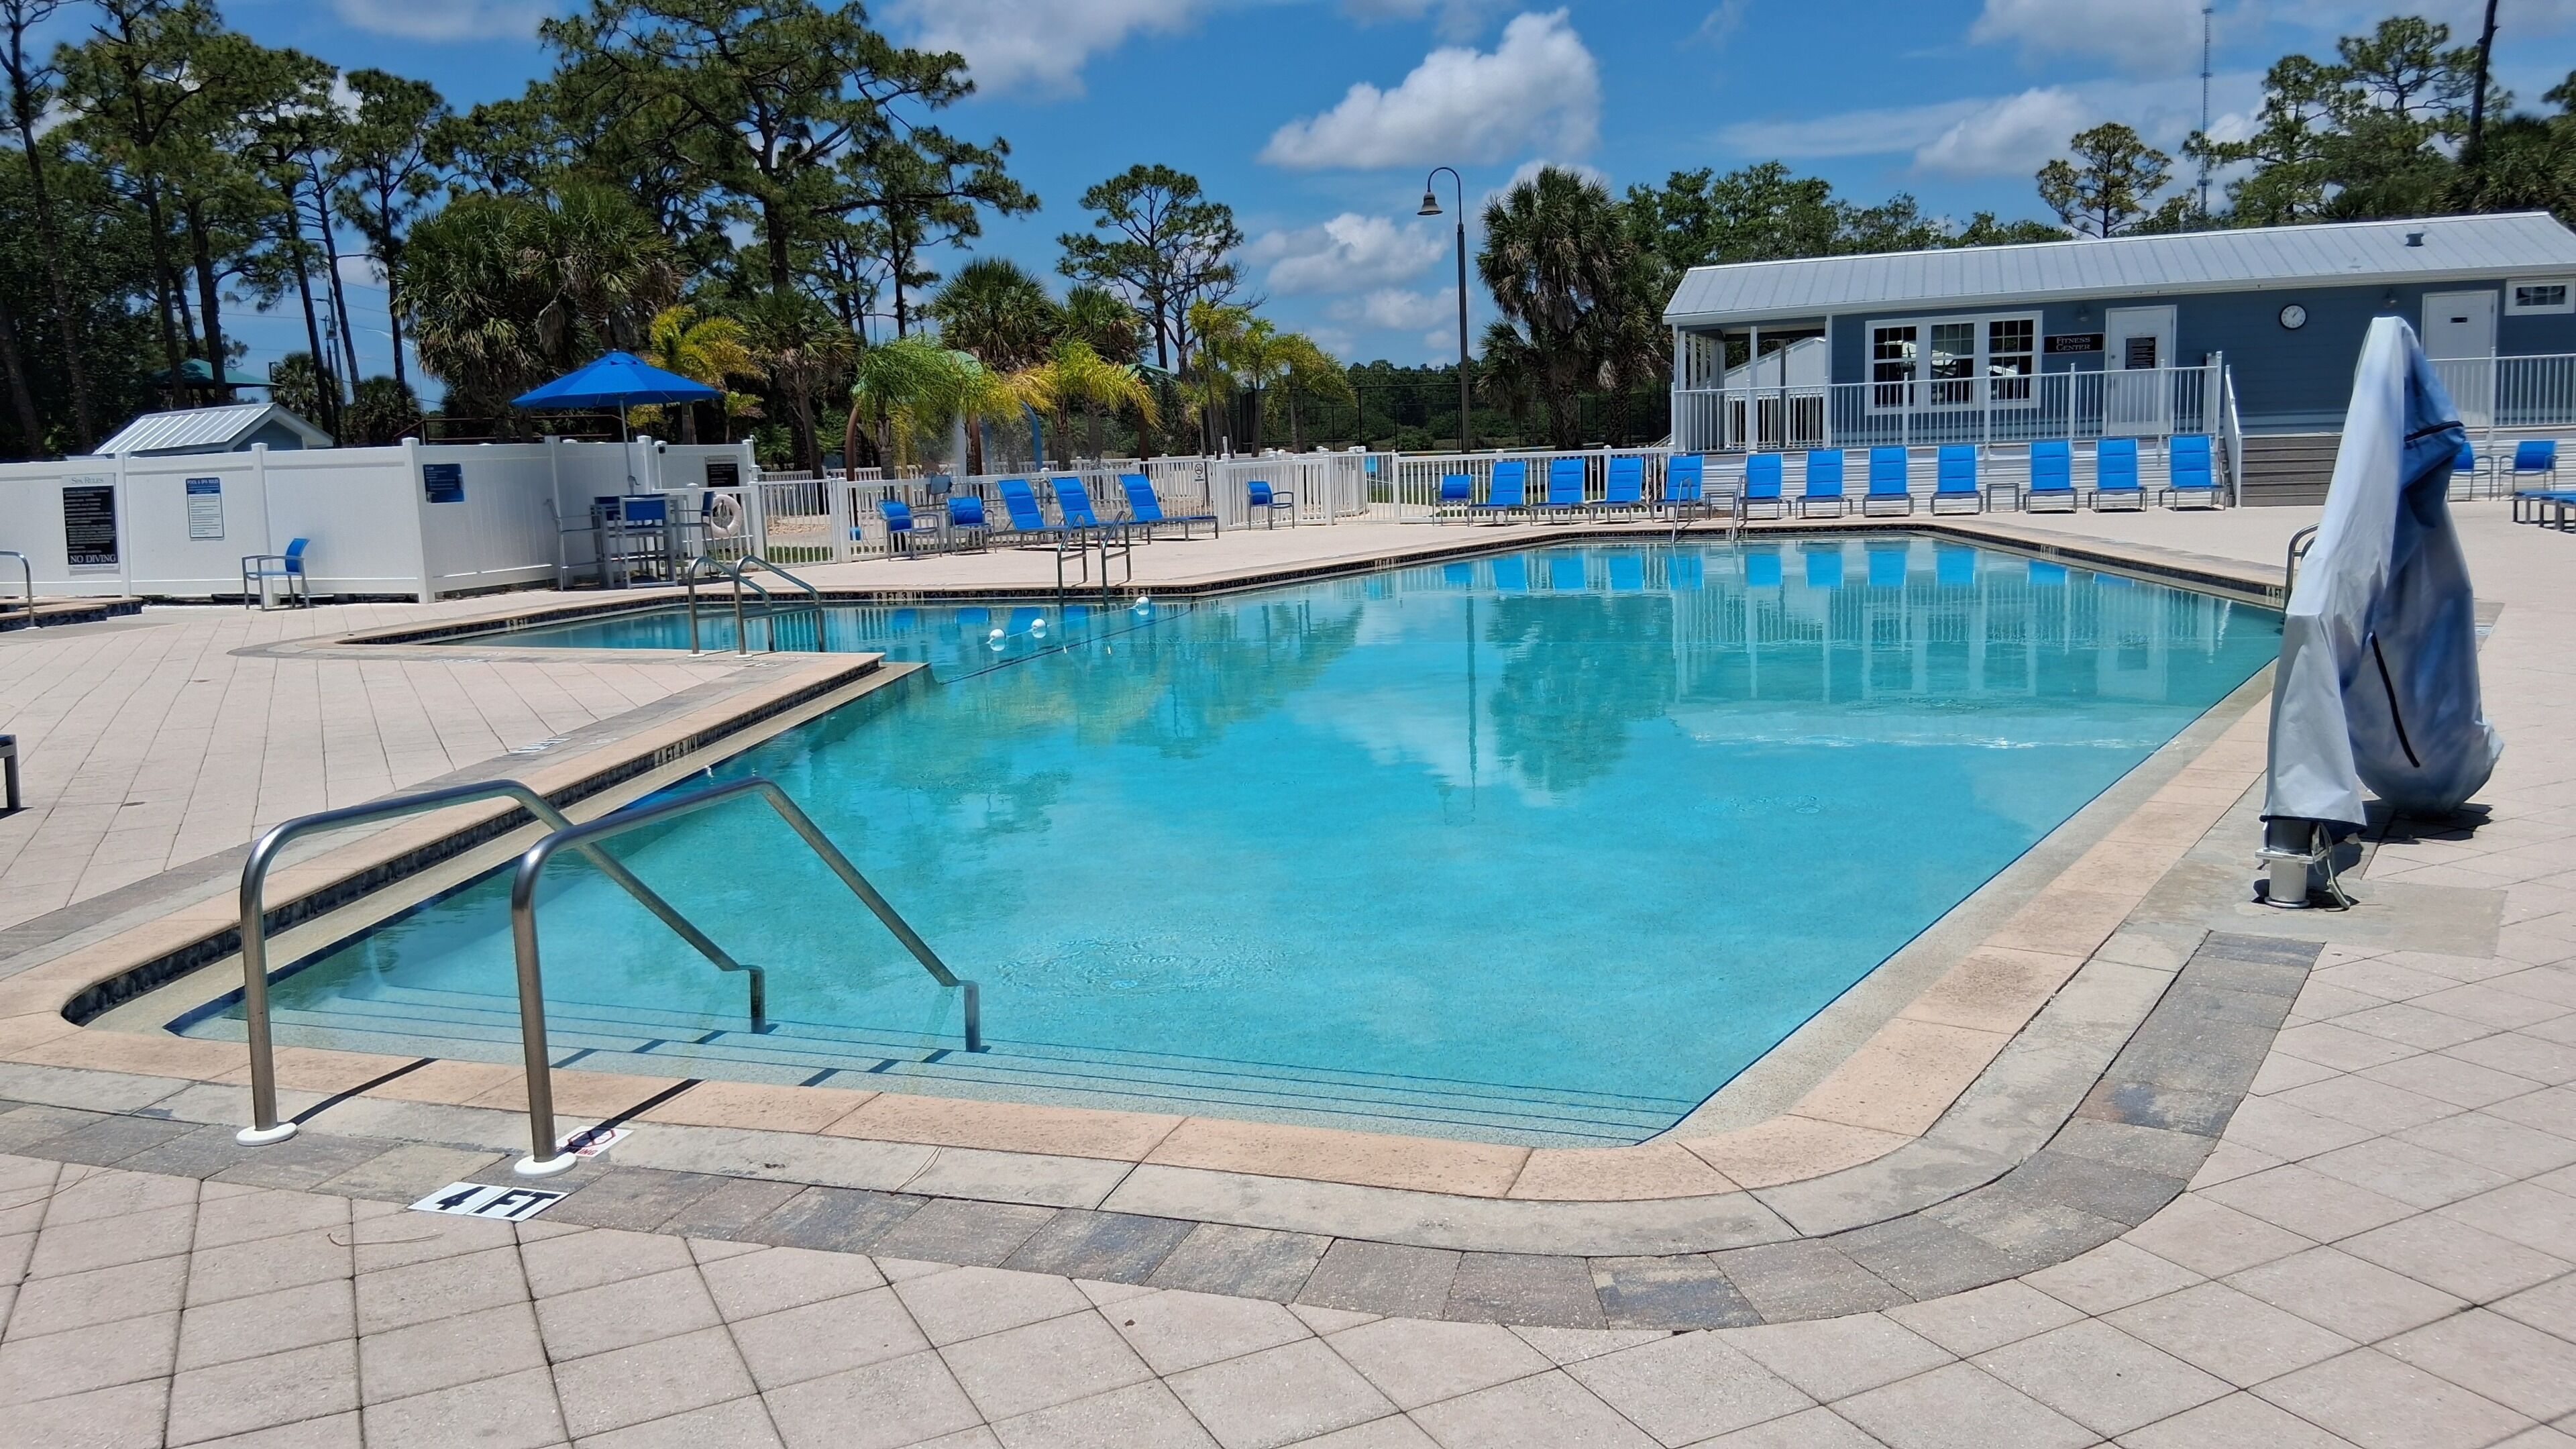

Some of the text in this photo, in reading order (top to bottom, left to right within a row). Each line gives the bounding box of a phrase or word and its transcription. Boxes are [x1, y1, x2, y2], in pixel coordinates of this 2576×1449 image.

[70, 554, 116, 564] NO DIVING
[886, 592, 898, 600] FT
[902, 591, 908, 600] 3
[912, 591, 922, 599] IN
[1128, 587, 1150, 596] 6 FT
[2268, 586, 2282, 598] 4 FT
[658, 737, 696, 763] 4 FT 8 IN
[435, 1185, 564, 1218] 4 FT
